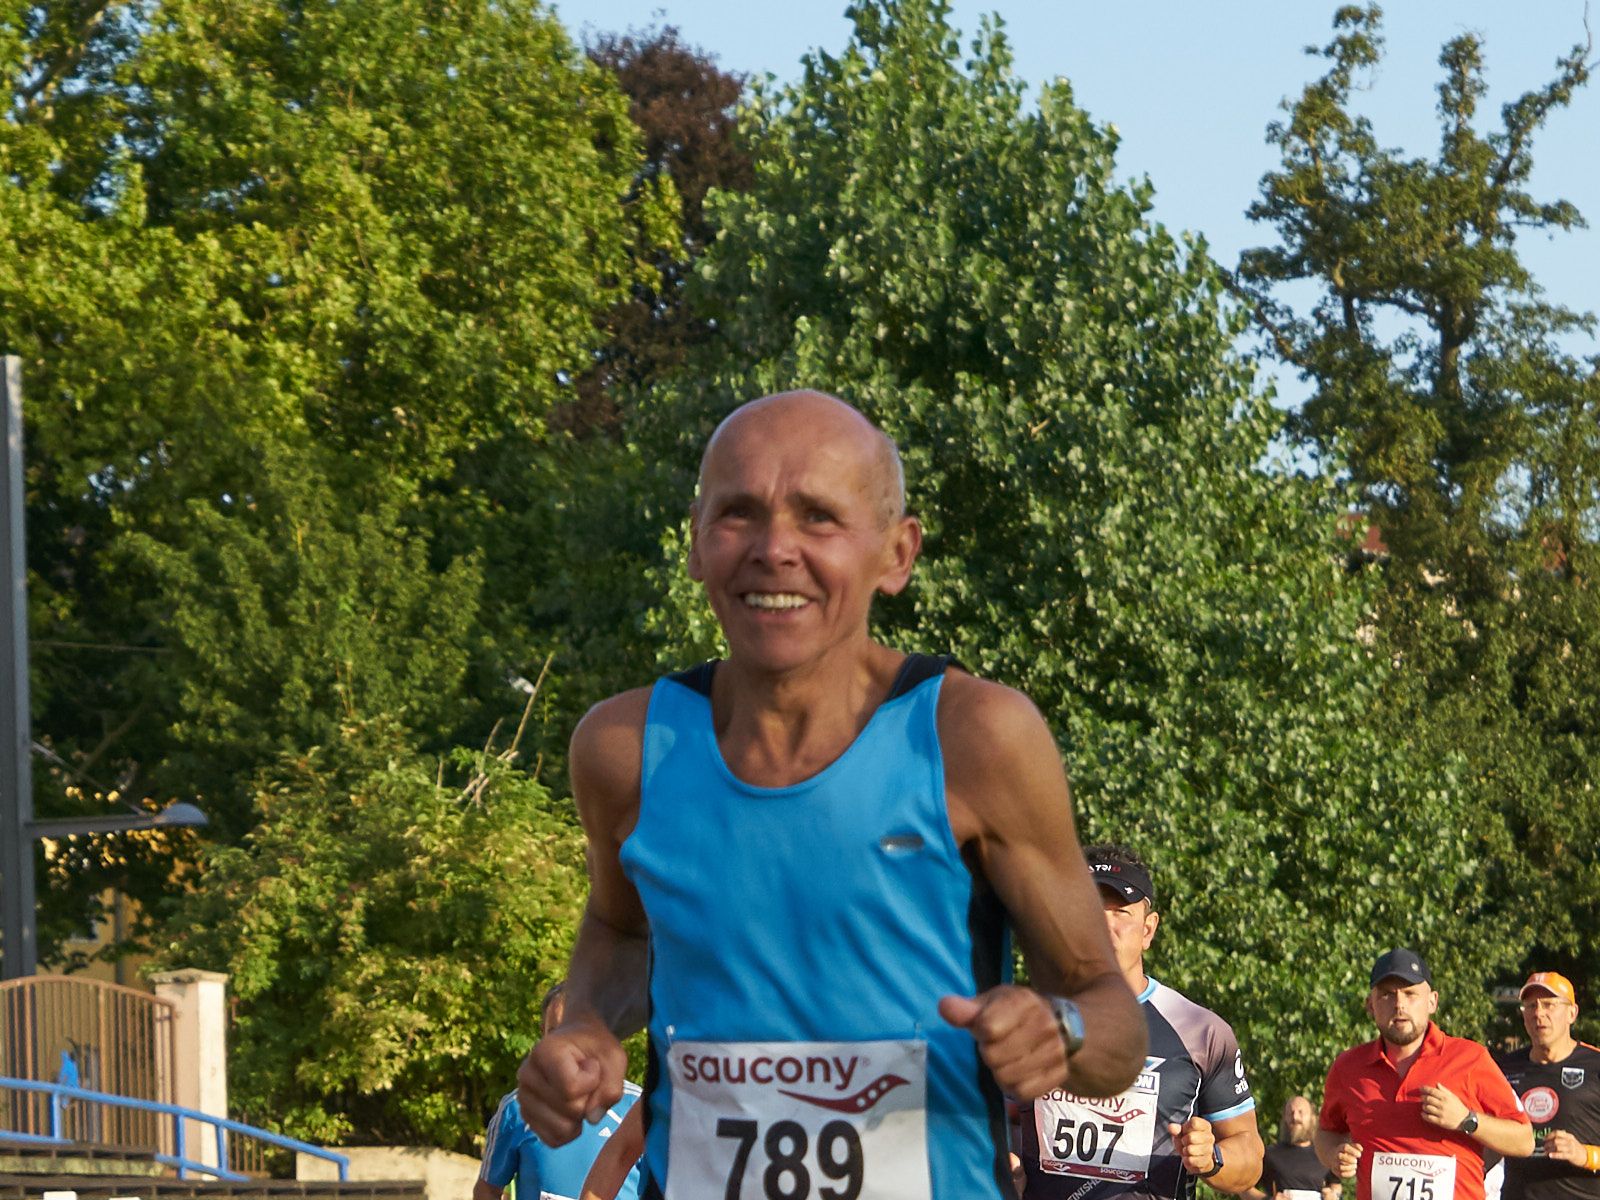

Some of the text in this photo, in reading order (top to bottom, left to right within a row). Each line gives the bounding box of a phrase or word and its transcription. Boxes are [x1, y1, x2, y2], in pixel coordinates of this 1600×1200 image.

[682, 1053, 858, 1091] saucony
[1052, 1118, 1125, 1165] 507
[1378, 1155, 1434, 1169] saucony
